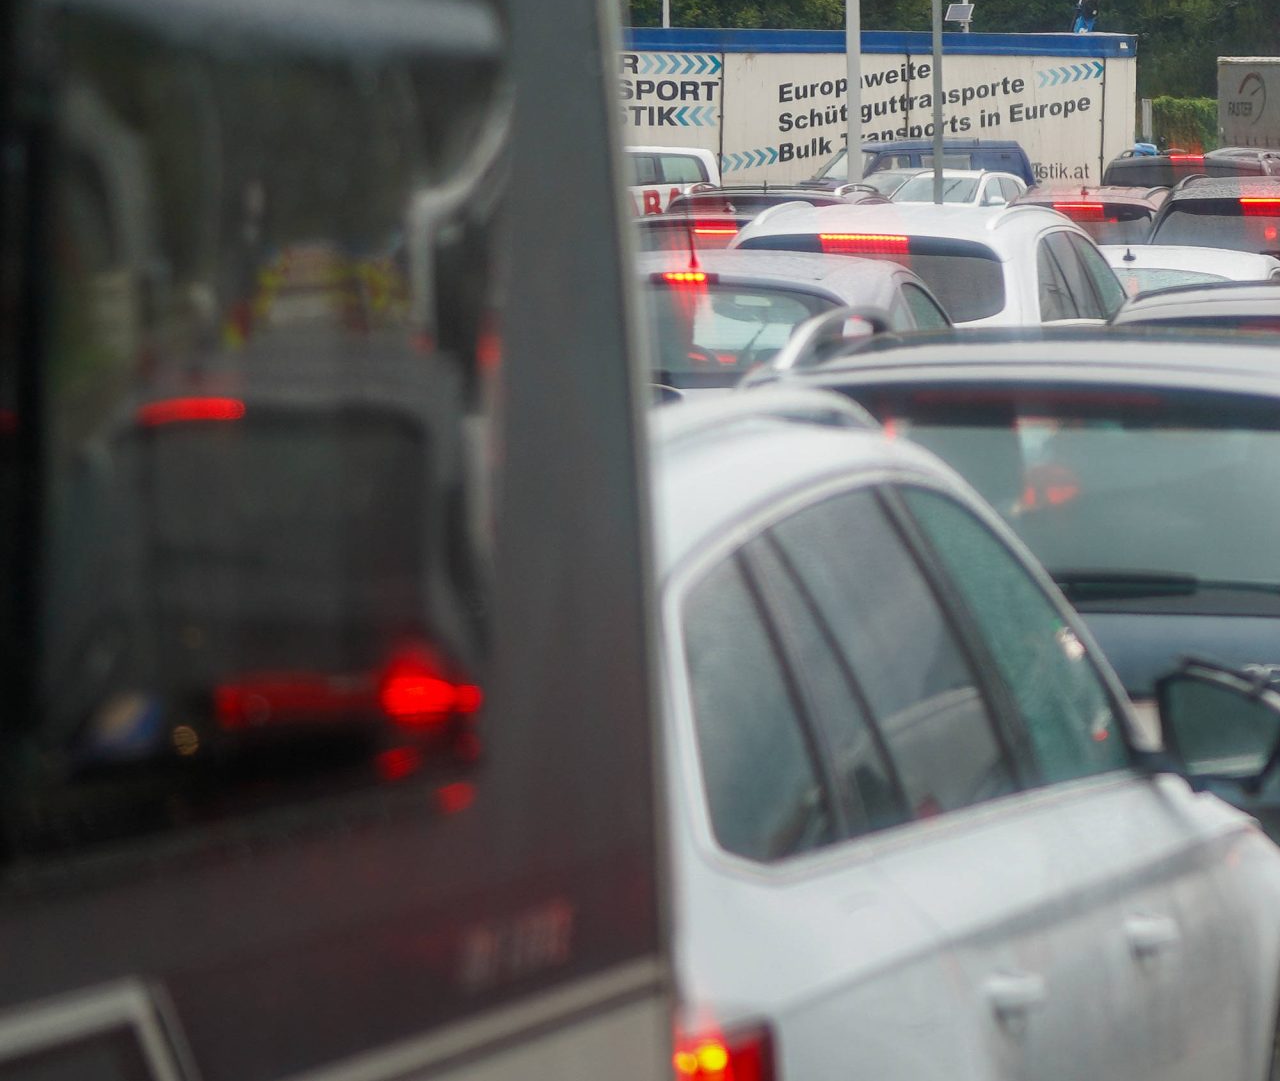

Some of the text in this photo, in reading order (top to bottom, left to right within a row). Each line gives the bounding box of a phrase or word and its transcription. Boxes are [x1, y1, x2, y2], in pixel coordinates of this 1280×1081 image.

[779, 62, 931, 103] Europweite
[779, 76, 1025, 133] Schütguttrasporte
[779, 137, 832, 162] Bulk
[980, 110, 1001, 128] in
[1009, 96, 1091, 123] Europe
